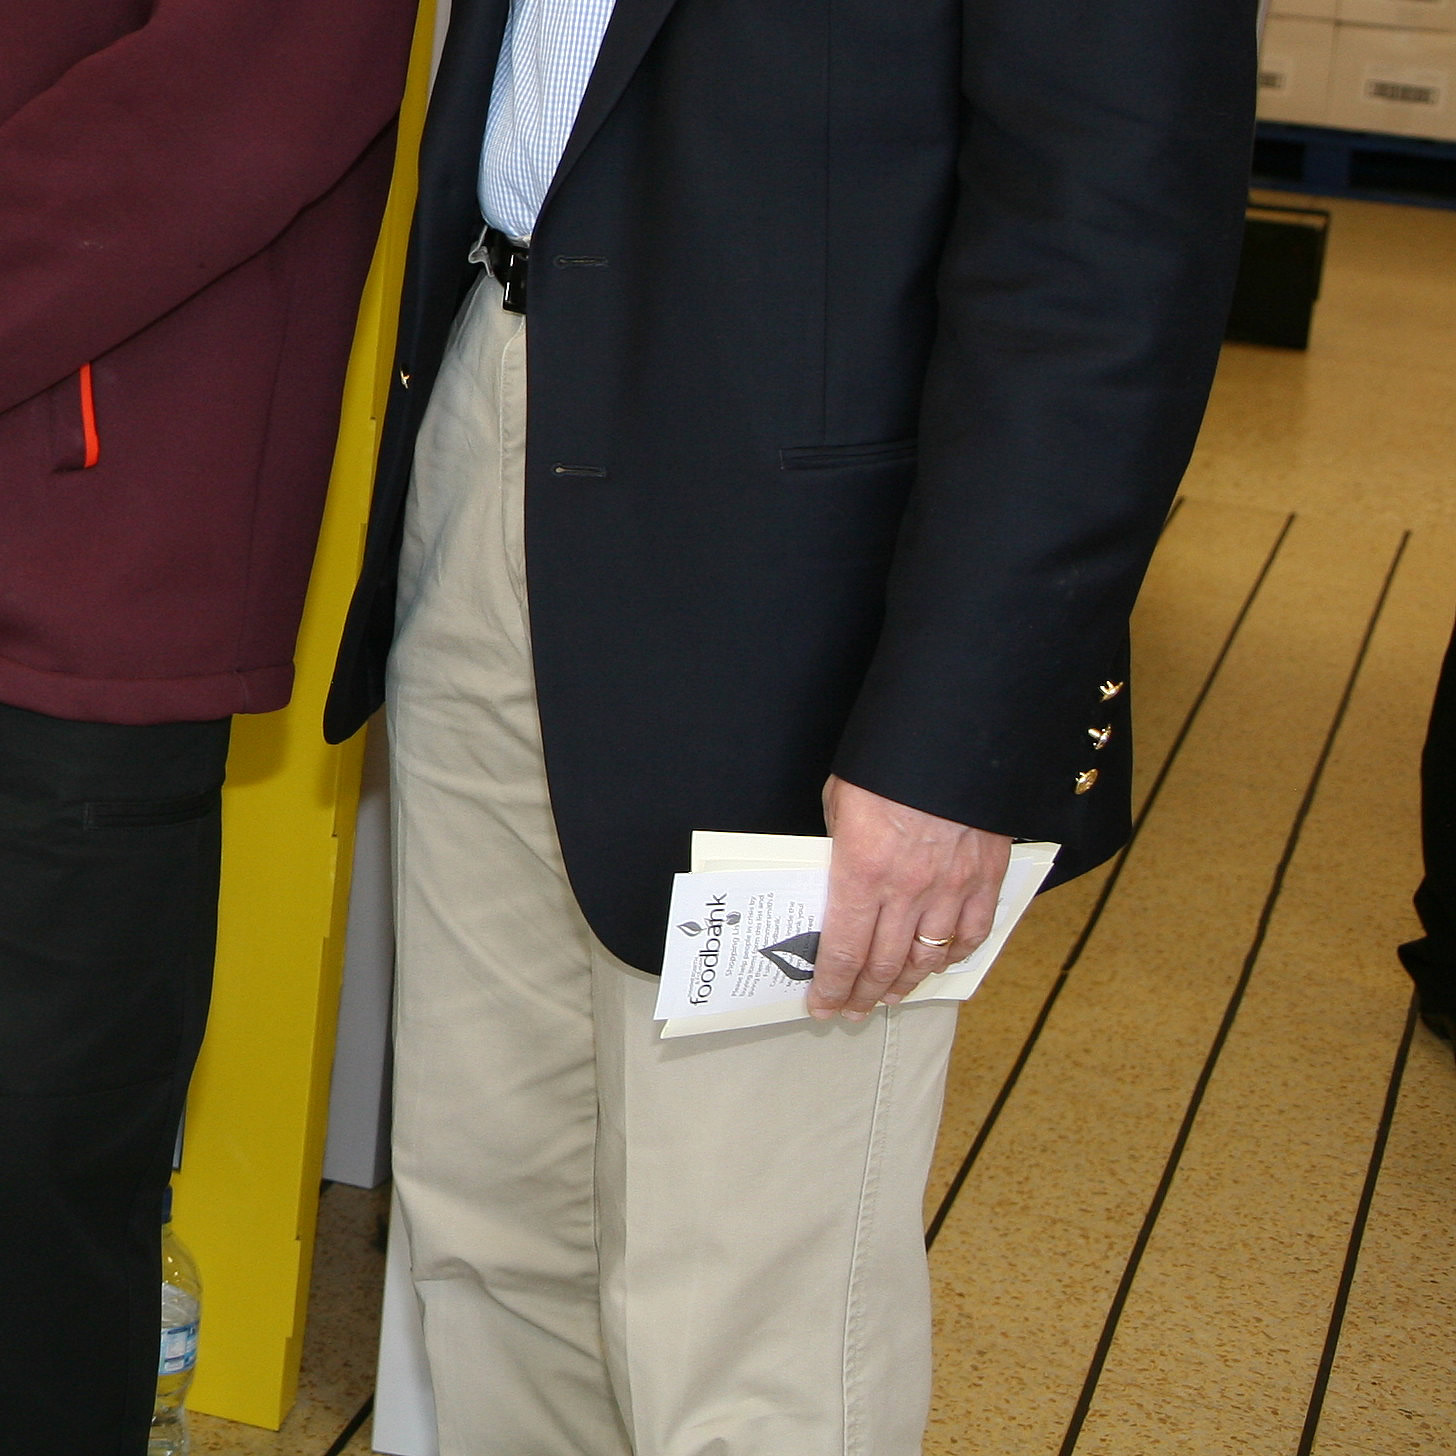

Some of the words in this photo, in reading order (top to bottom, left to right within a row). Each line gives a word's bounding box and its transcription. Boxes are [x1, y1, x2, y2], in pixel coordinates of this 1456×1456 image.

[688, 891, 728, 1007] foodbank
[724, 937, 740, 977] Shopping
[731, 977, 744, 997] Please
[738, 960, 748, 975] help
[743, 935, 752, 959] people
[749, 895, 757, 906] by
